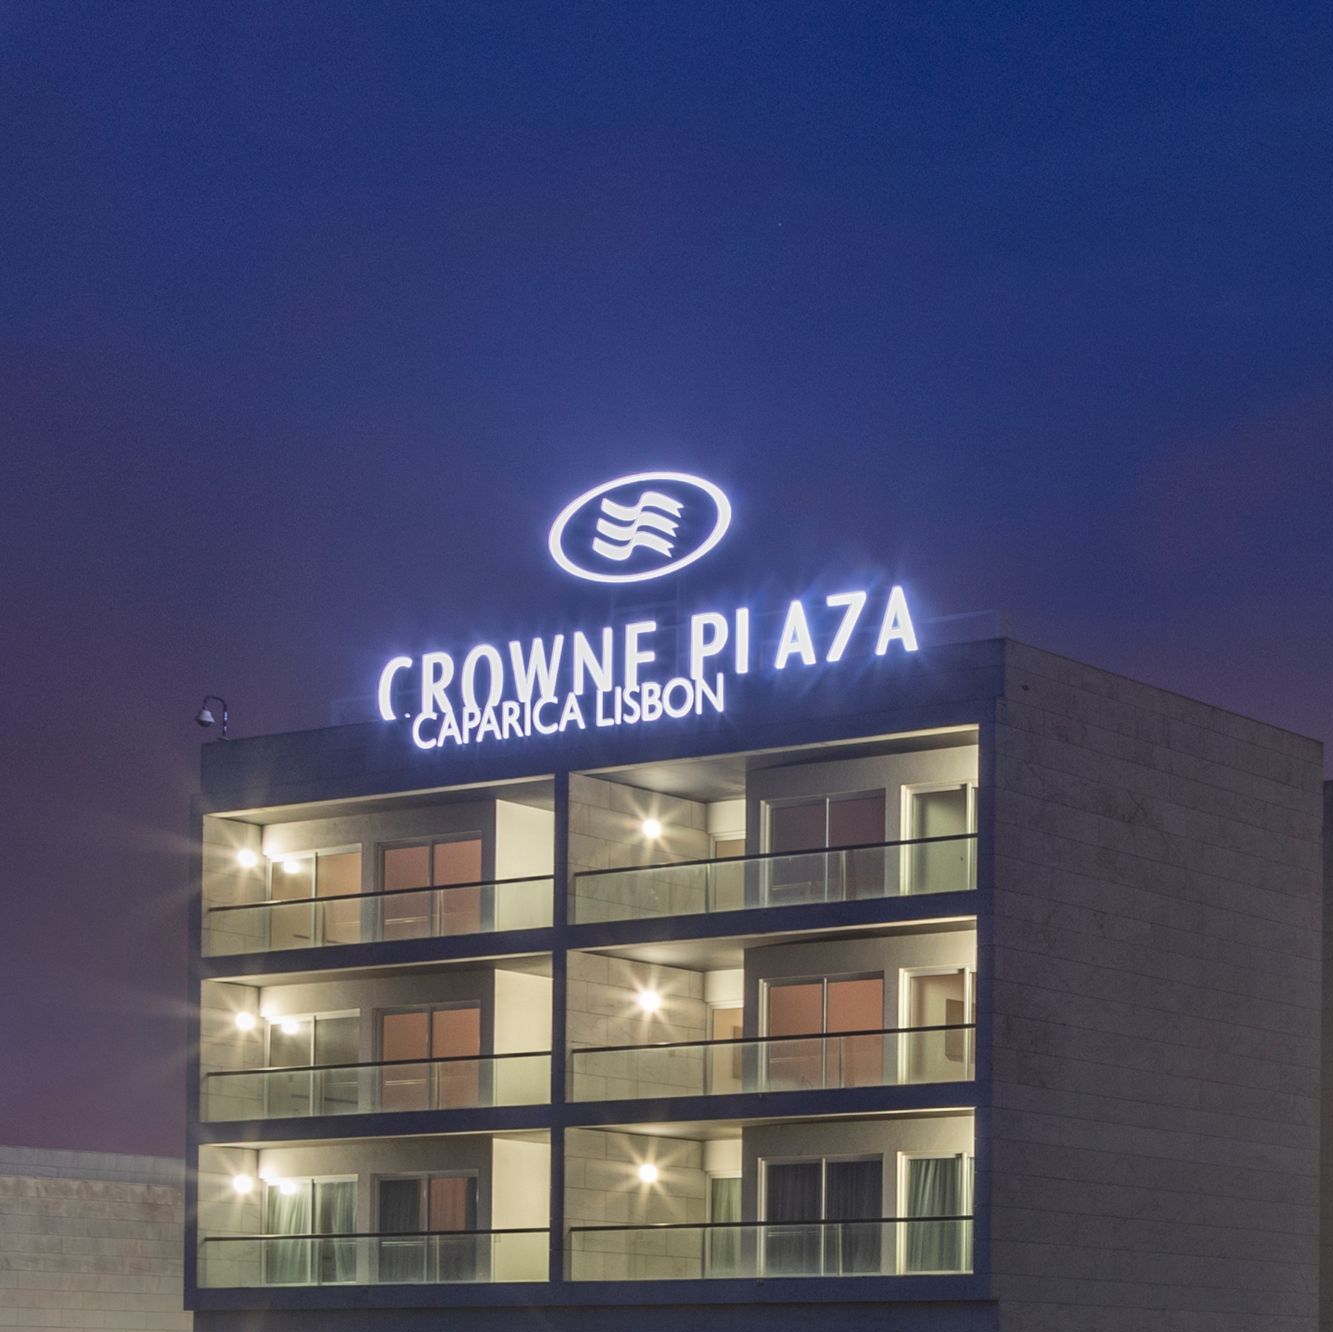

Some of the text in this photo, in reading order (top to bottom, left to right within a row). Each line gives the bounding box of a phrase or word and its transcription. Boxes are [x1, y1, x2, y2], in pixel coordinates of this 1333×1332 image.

[377, 621, 656, 721] CROWNE
[412, 672, 724, 749] CAPARICA LISBON
